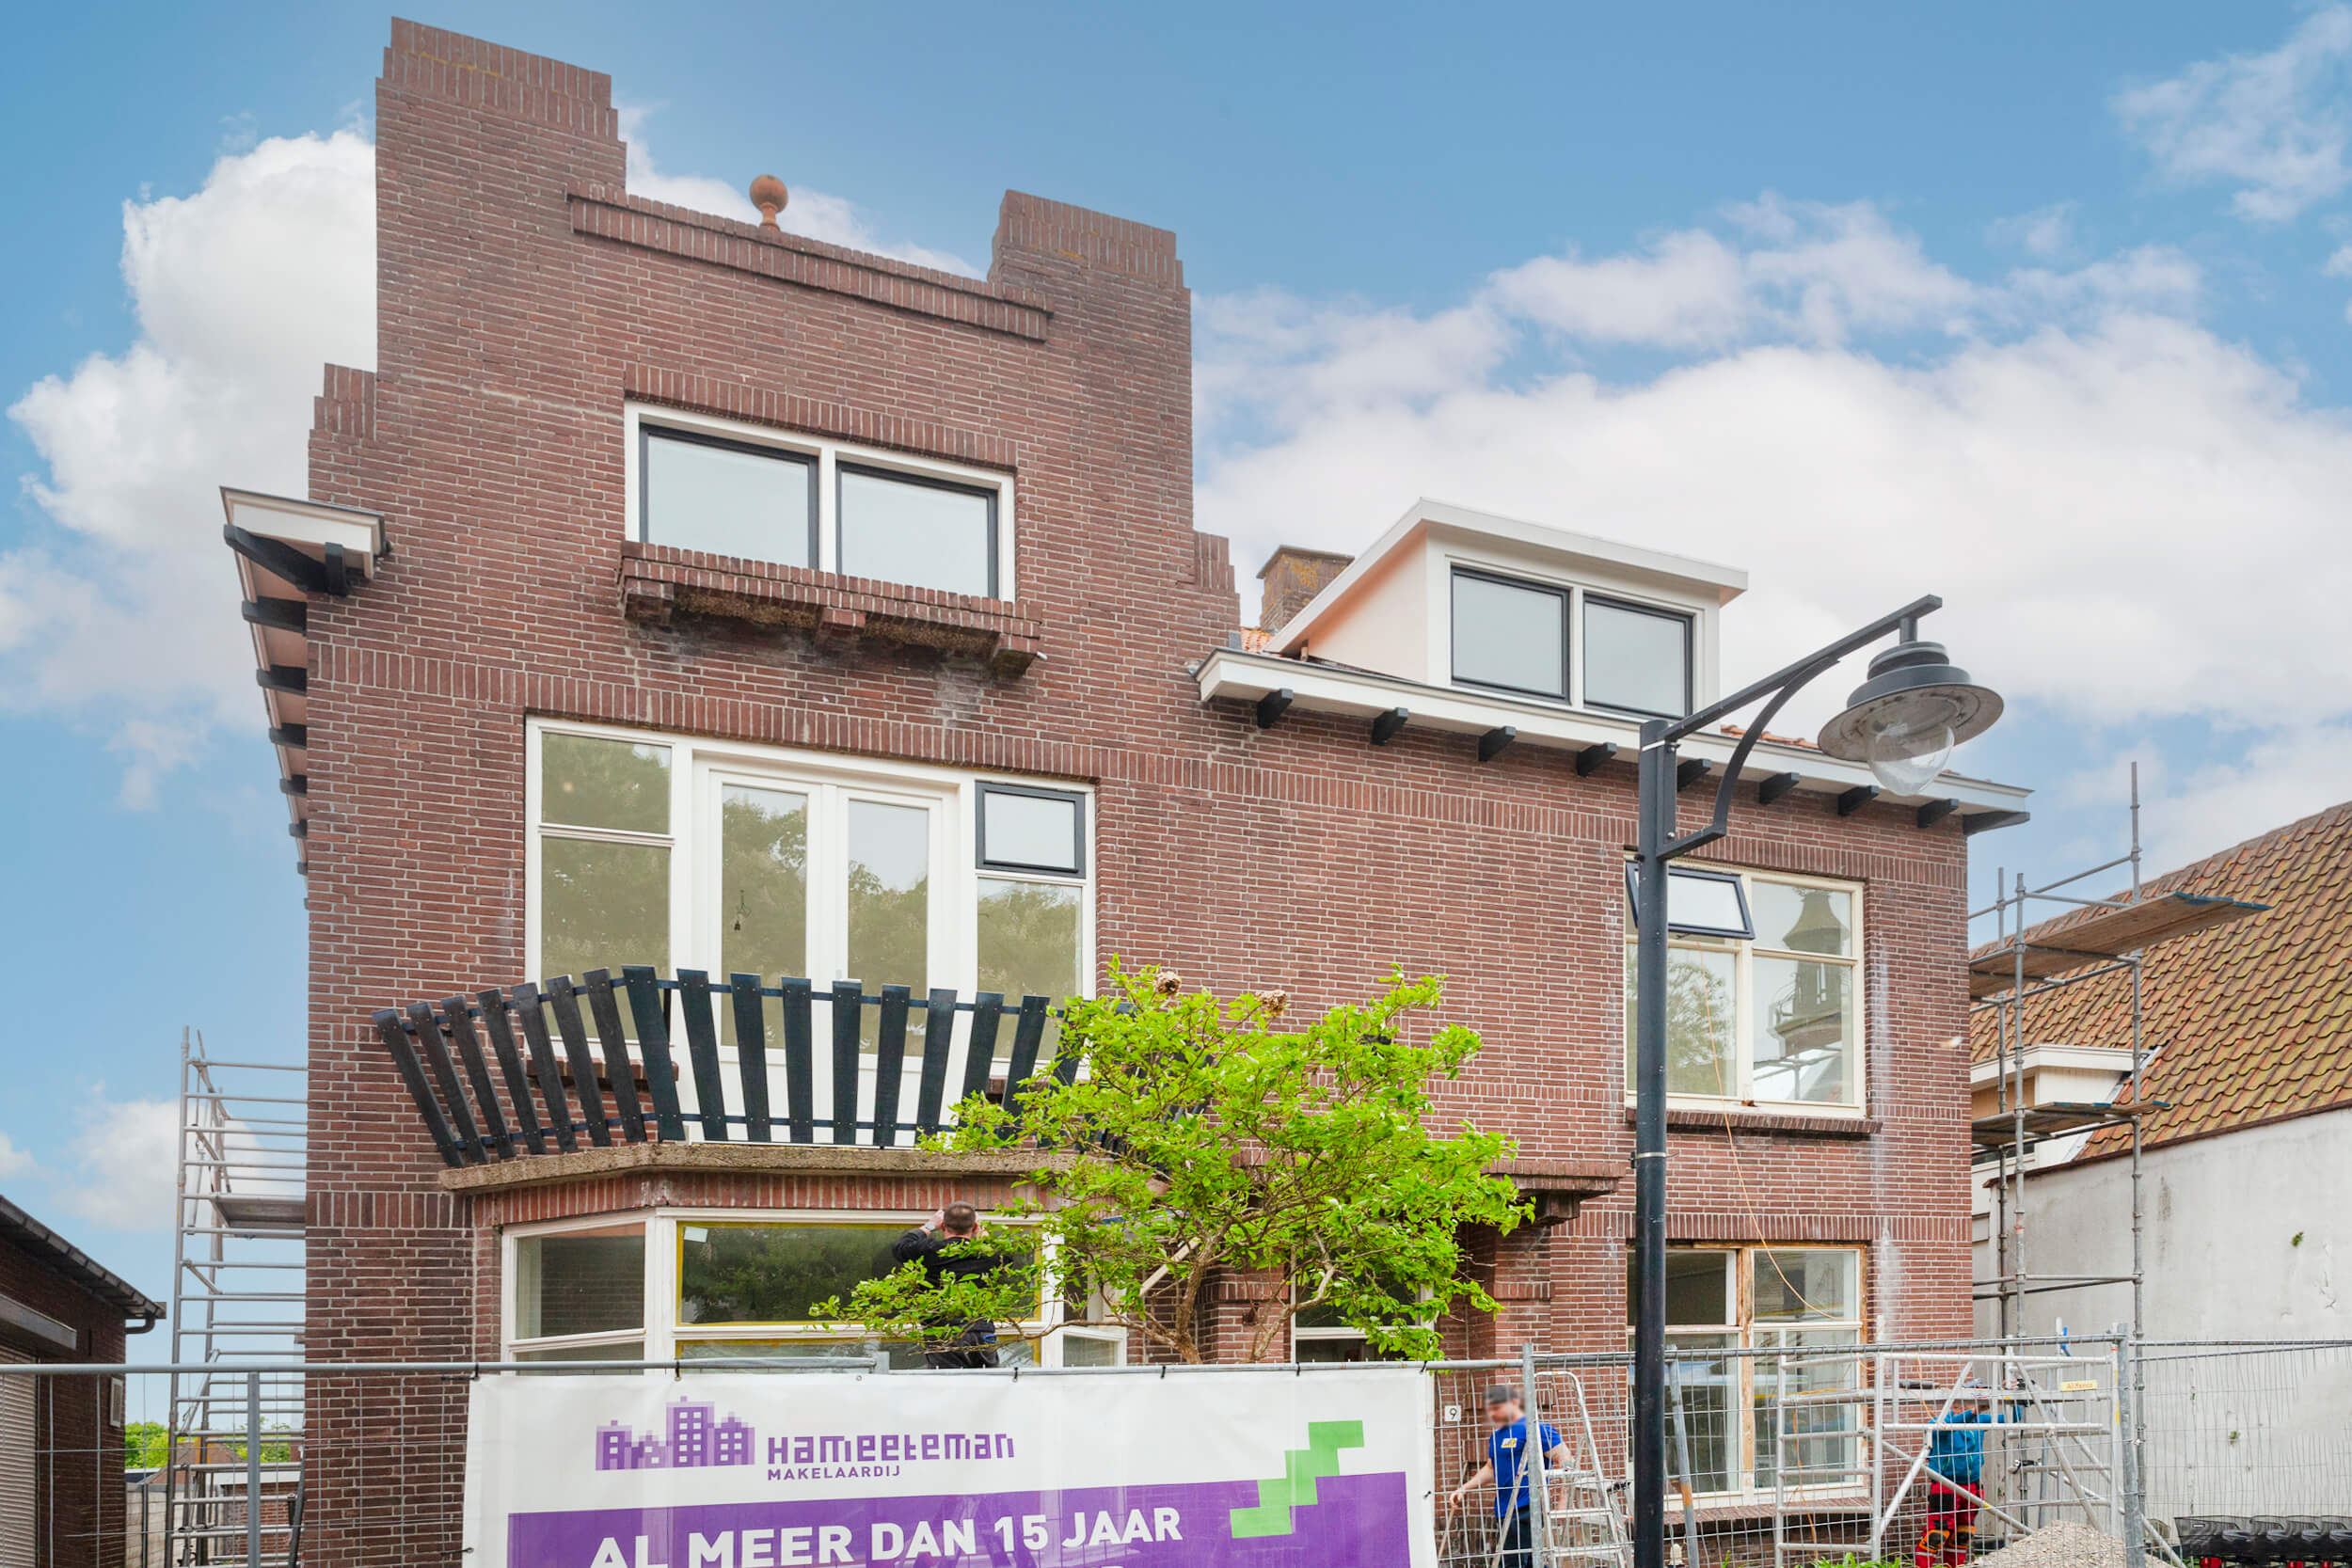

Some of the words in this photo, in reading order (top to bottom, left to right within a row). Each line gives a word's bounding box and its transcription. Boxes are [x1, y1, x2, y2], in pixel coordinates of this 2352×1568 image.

[1449, 1407, 1457, 1419] 9
[768, 1433, 1014, 1464] Hameeteman
[768, 1465, 899, 1481] MAKELAARDIJ
[590, 1536, 668, 1568] AL
[689, 1525, 854, 1568] MEER
[871, 1518, 977, 1560] DAN
[993, 1514, 1049, 1550] 15
[1062, 1507, 1183, 1548] JAAR
